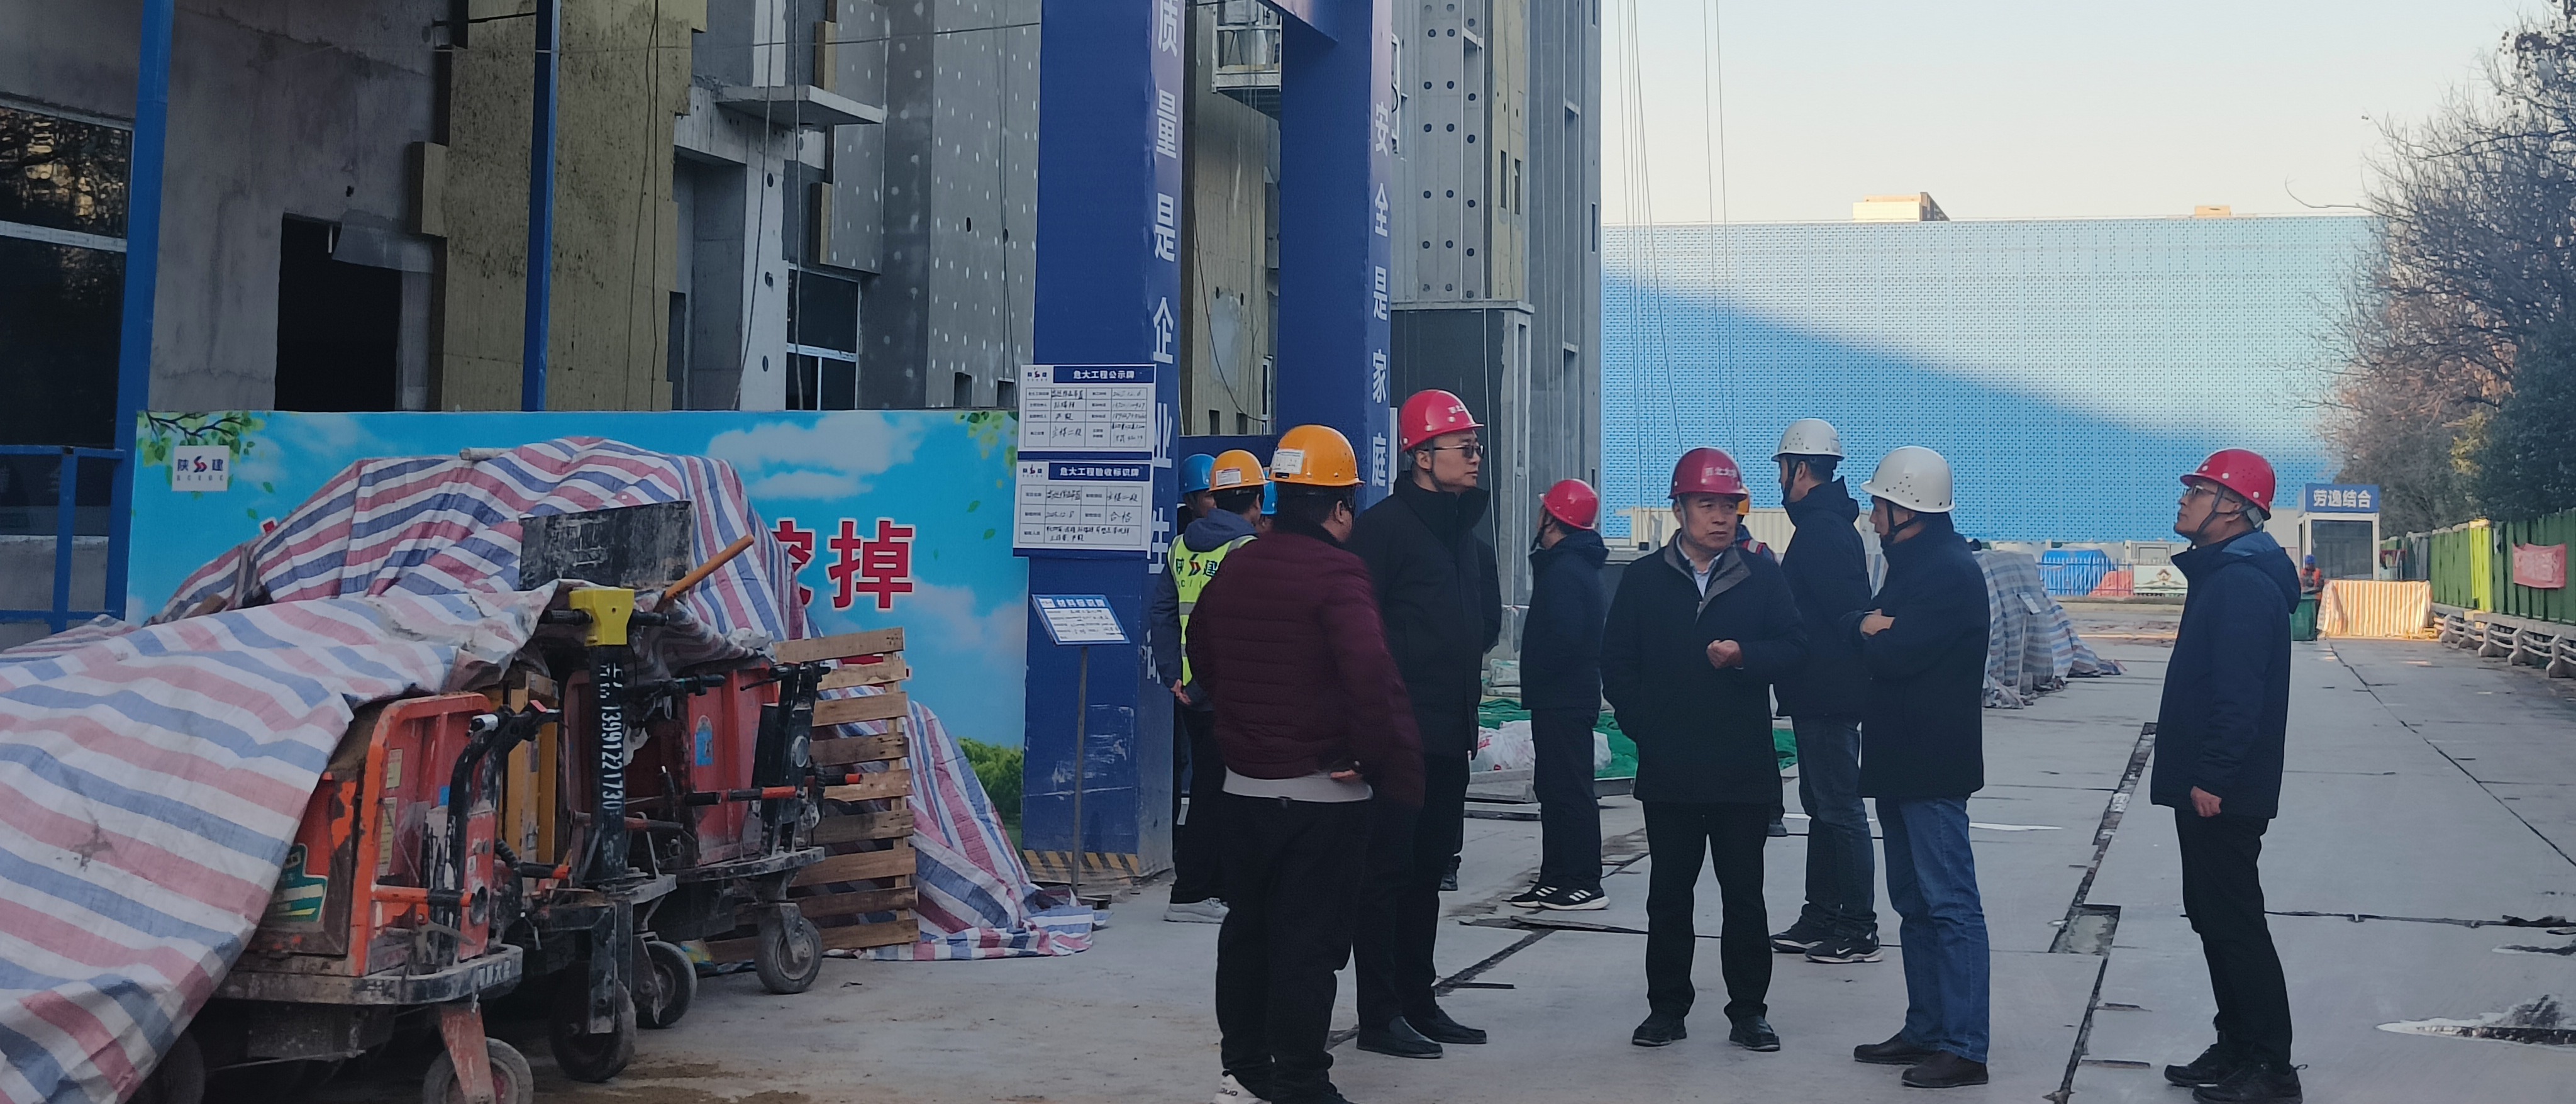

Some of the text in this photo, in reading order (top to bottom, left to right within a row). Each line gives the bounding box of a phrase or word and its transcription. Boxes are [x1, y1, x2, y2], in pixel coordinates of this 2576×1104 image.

[1372, 101, 1389, 487] 安全是家庭
[2313, 489, 2372, 508] 劳逸结合
[601, 704, 623, 810] 13991221730
